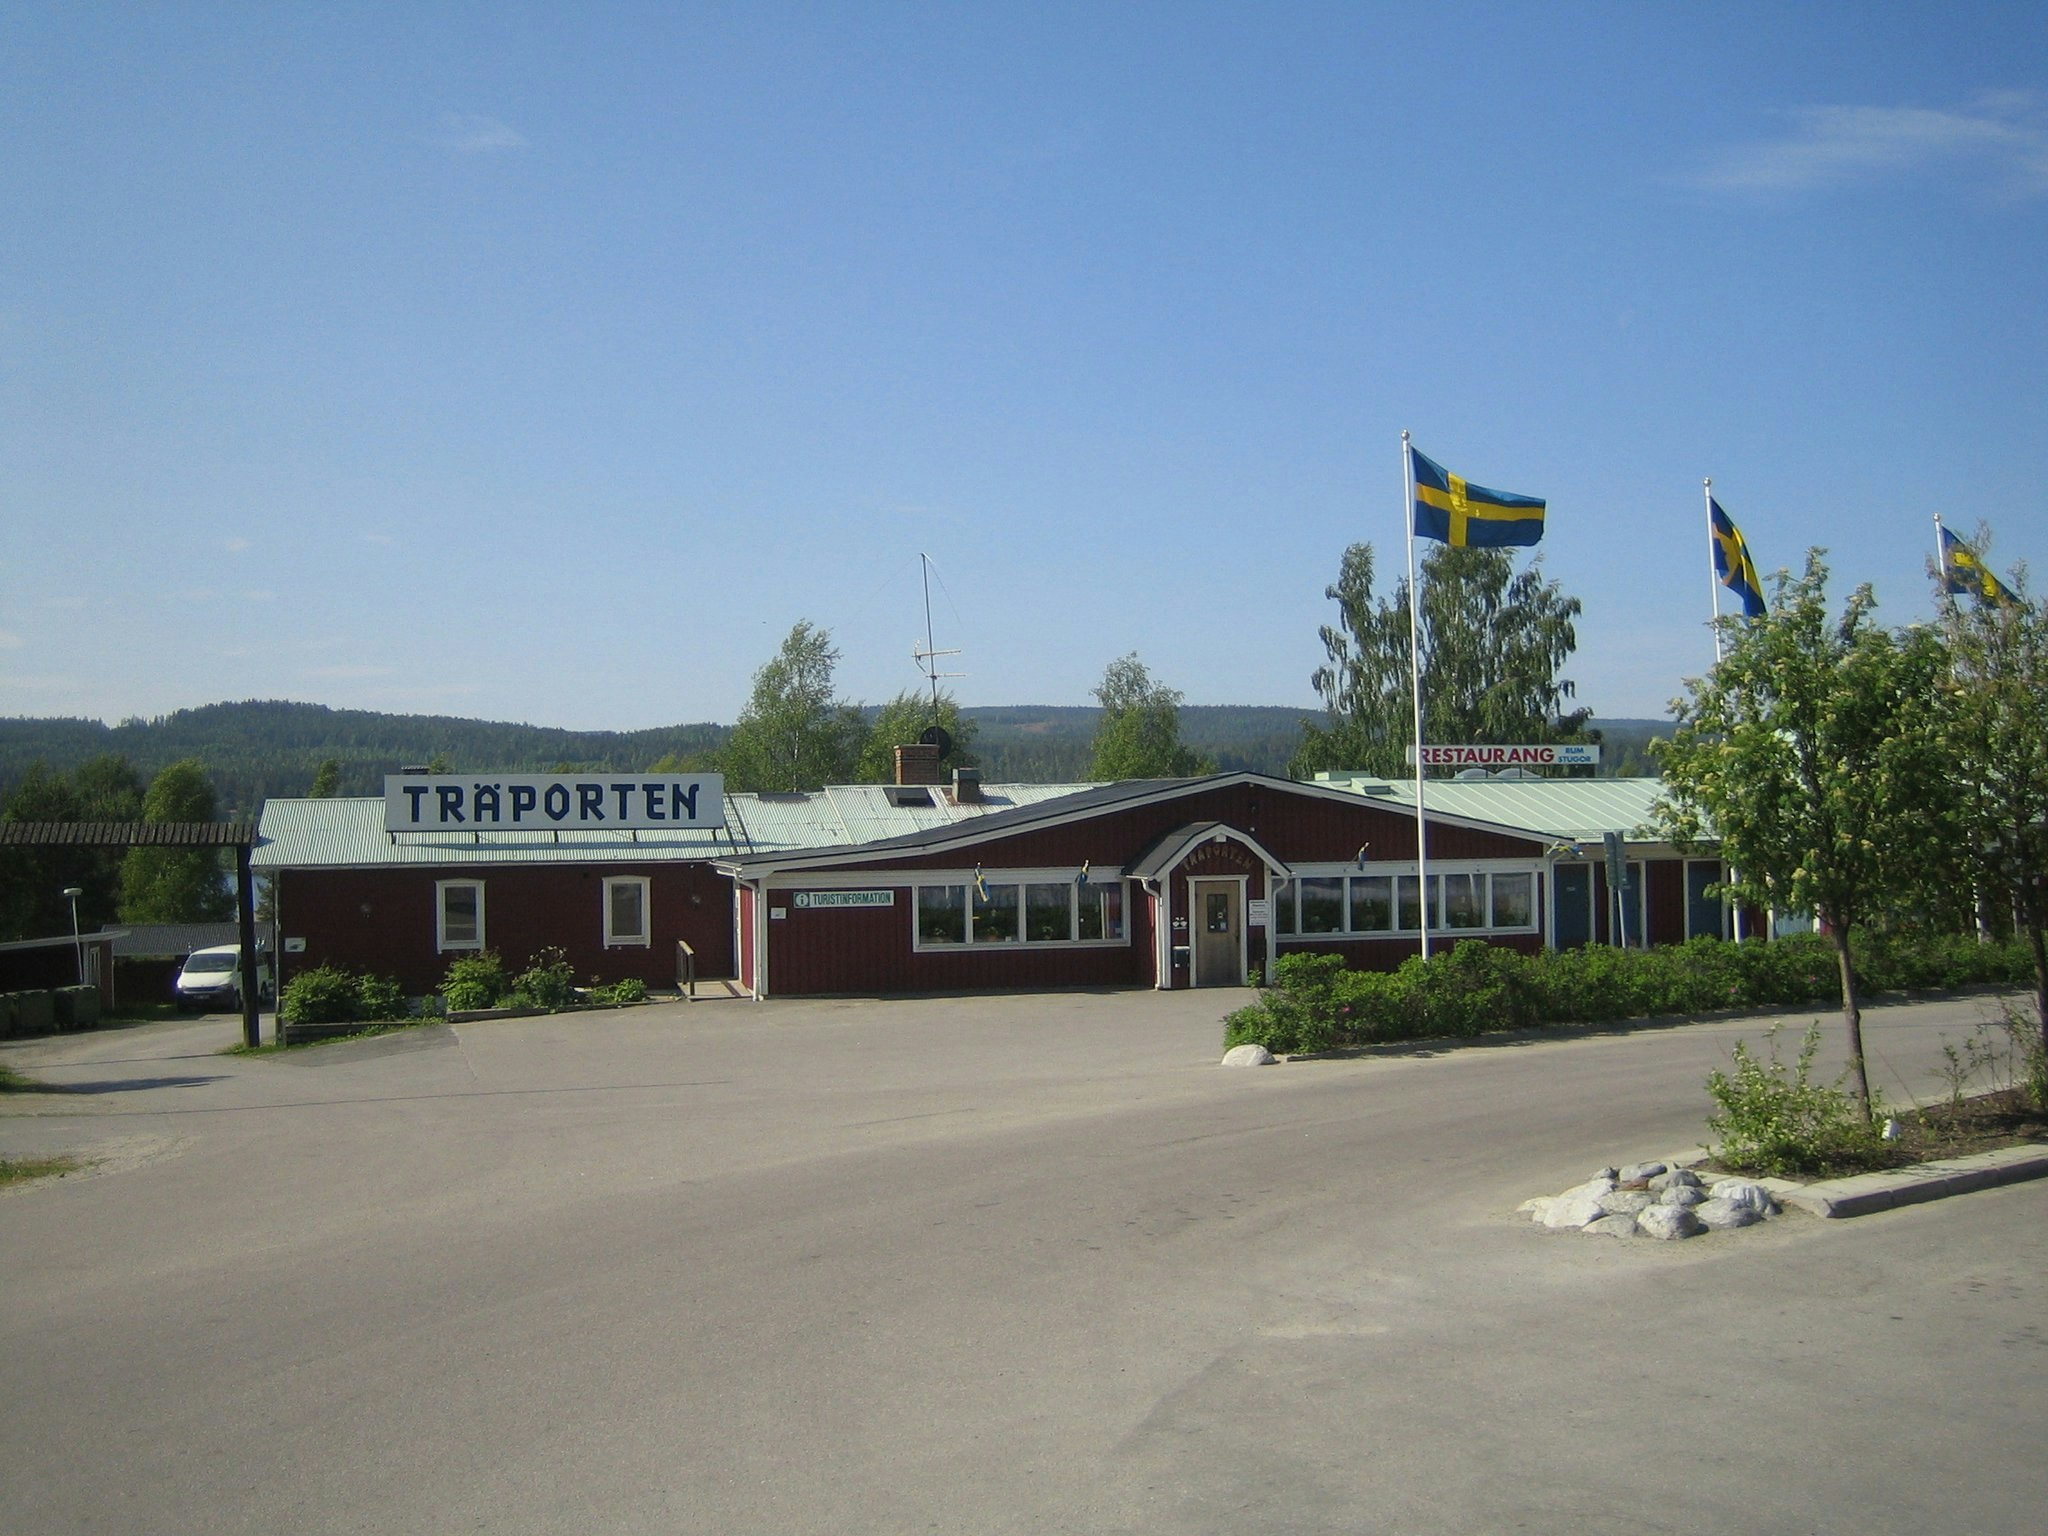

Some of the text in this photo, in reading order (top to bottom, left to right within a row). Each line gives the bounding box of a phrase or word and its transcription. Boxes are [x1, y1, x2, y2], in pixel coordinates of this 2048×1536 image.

[1421, 747, 1554, 763] RESTAURANG
[402, 782, 700, 823] TRÄPORTEN
[813, 892, 891, 905] TURISTINFORMATION
